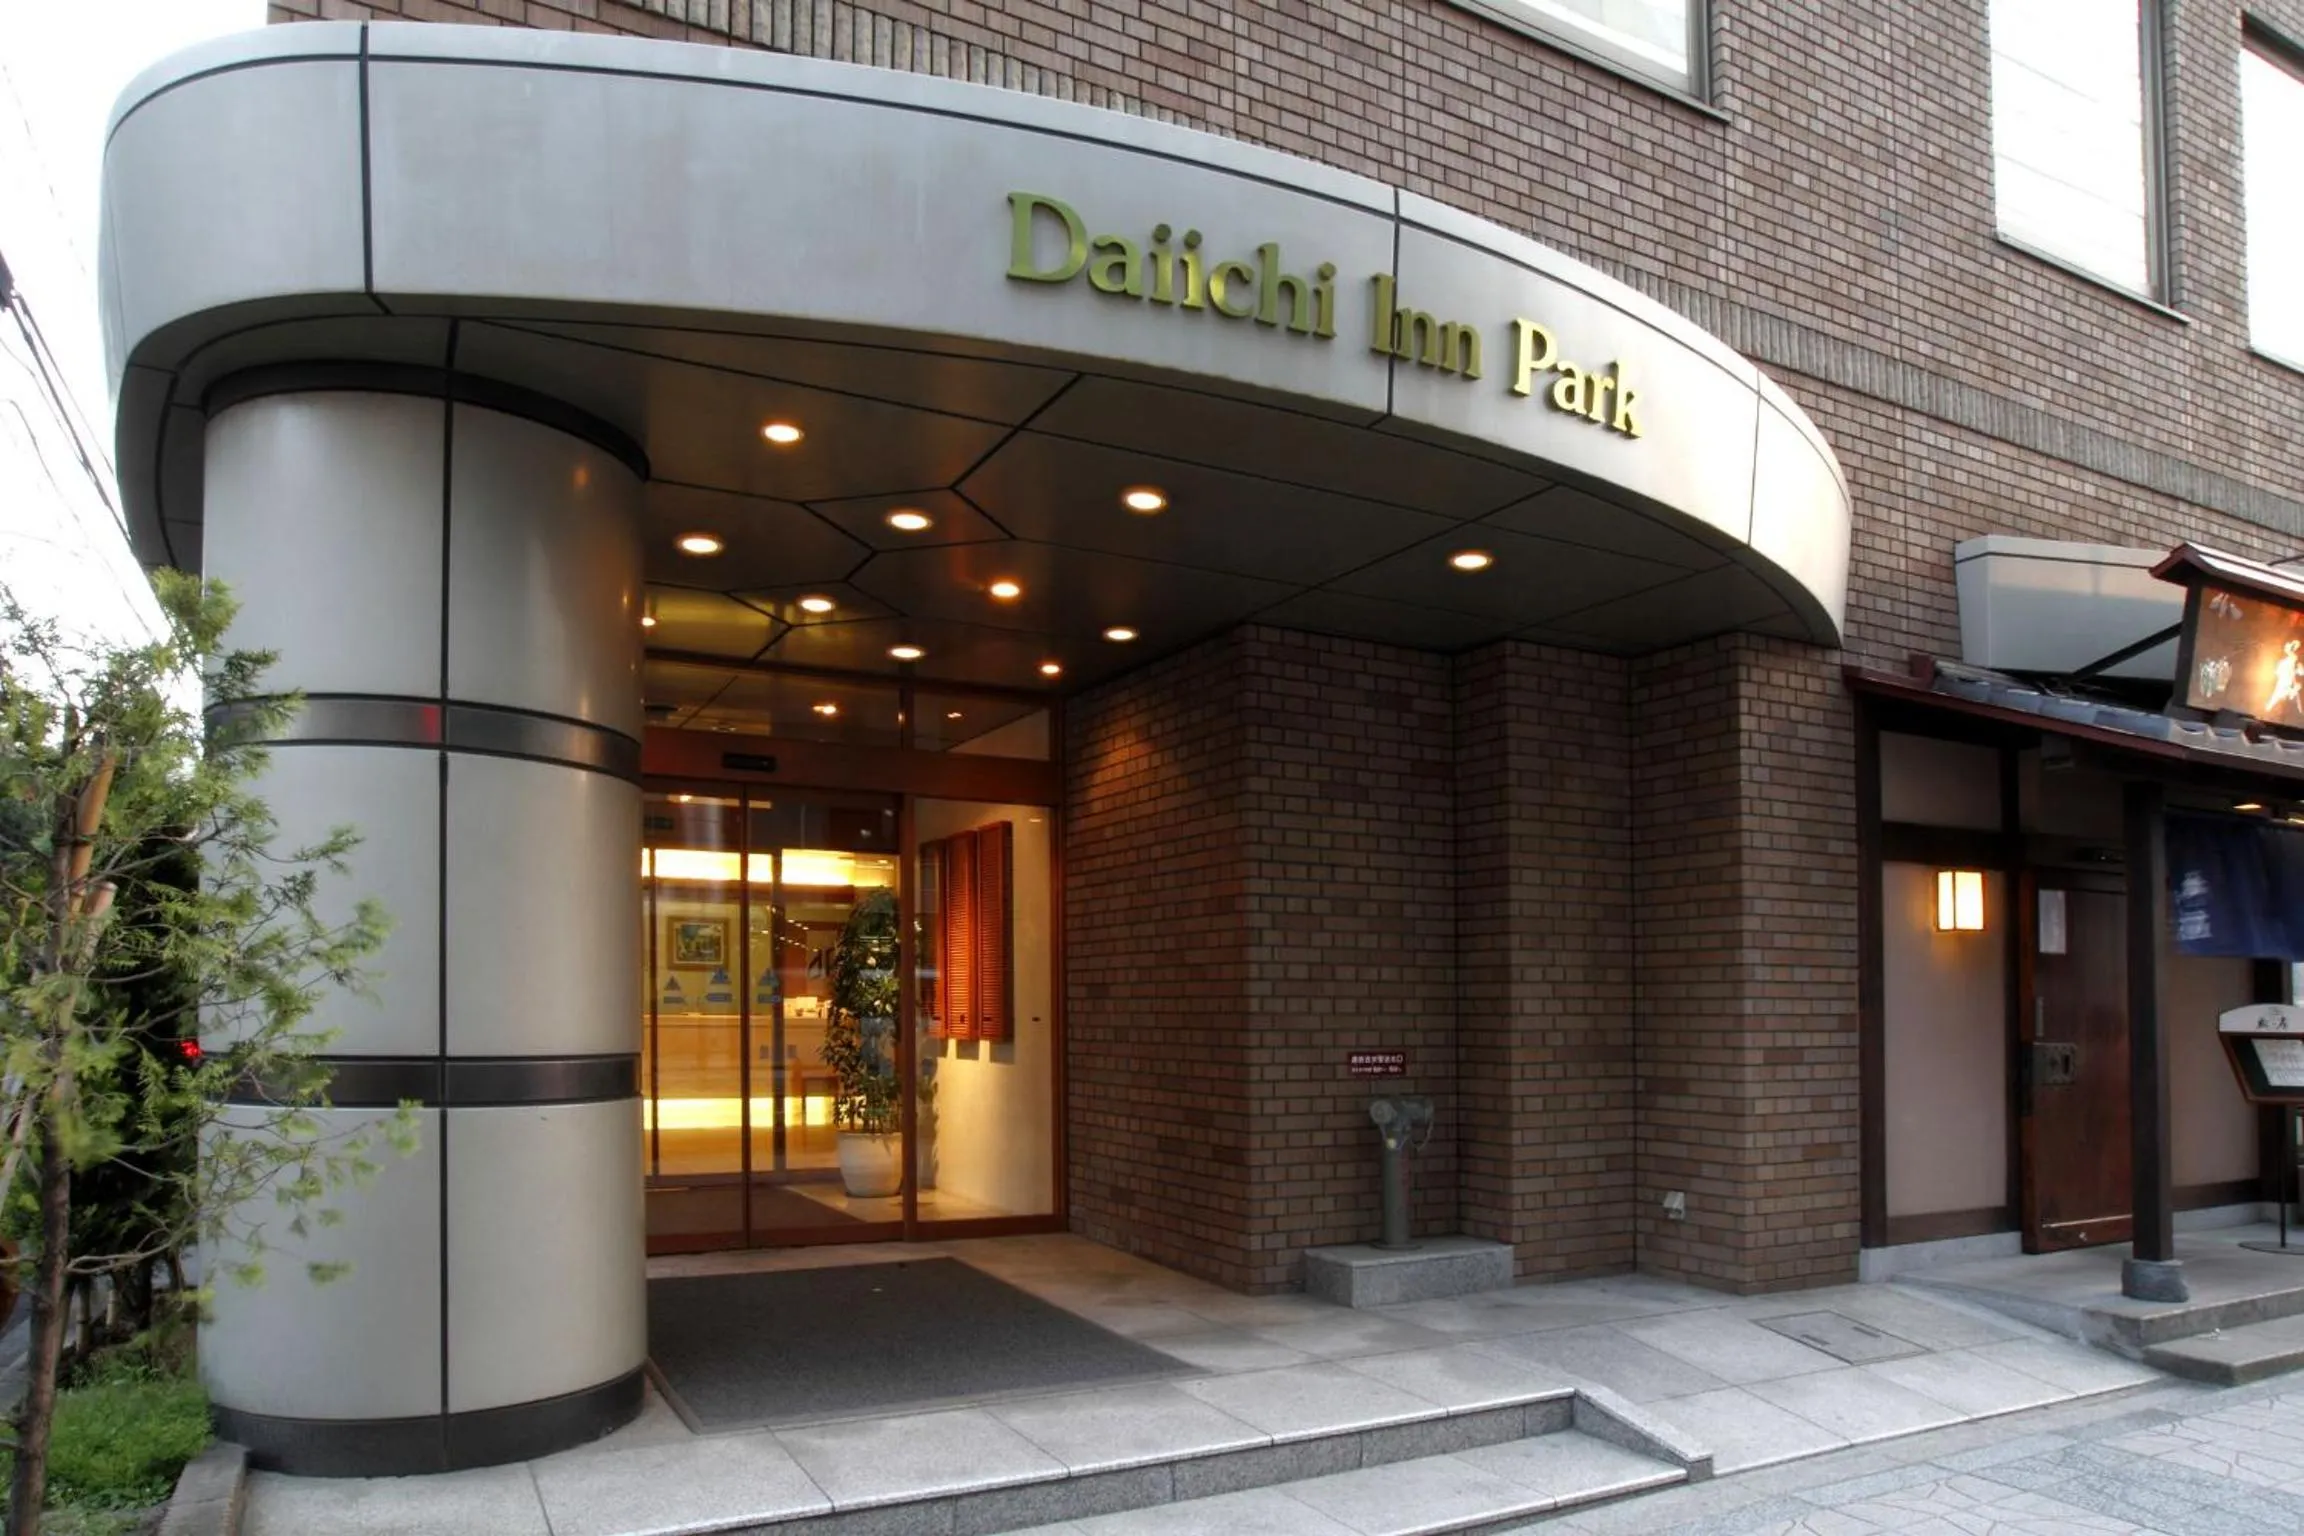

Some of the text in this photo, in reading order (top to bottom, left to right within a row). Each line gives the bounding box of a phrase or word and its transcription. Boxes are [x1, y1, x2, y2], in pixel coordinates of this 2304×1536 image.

[1006, 191, 1642, 439] Daiichi Inn Park
